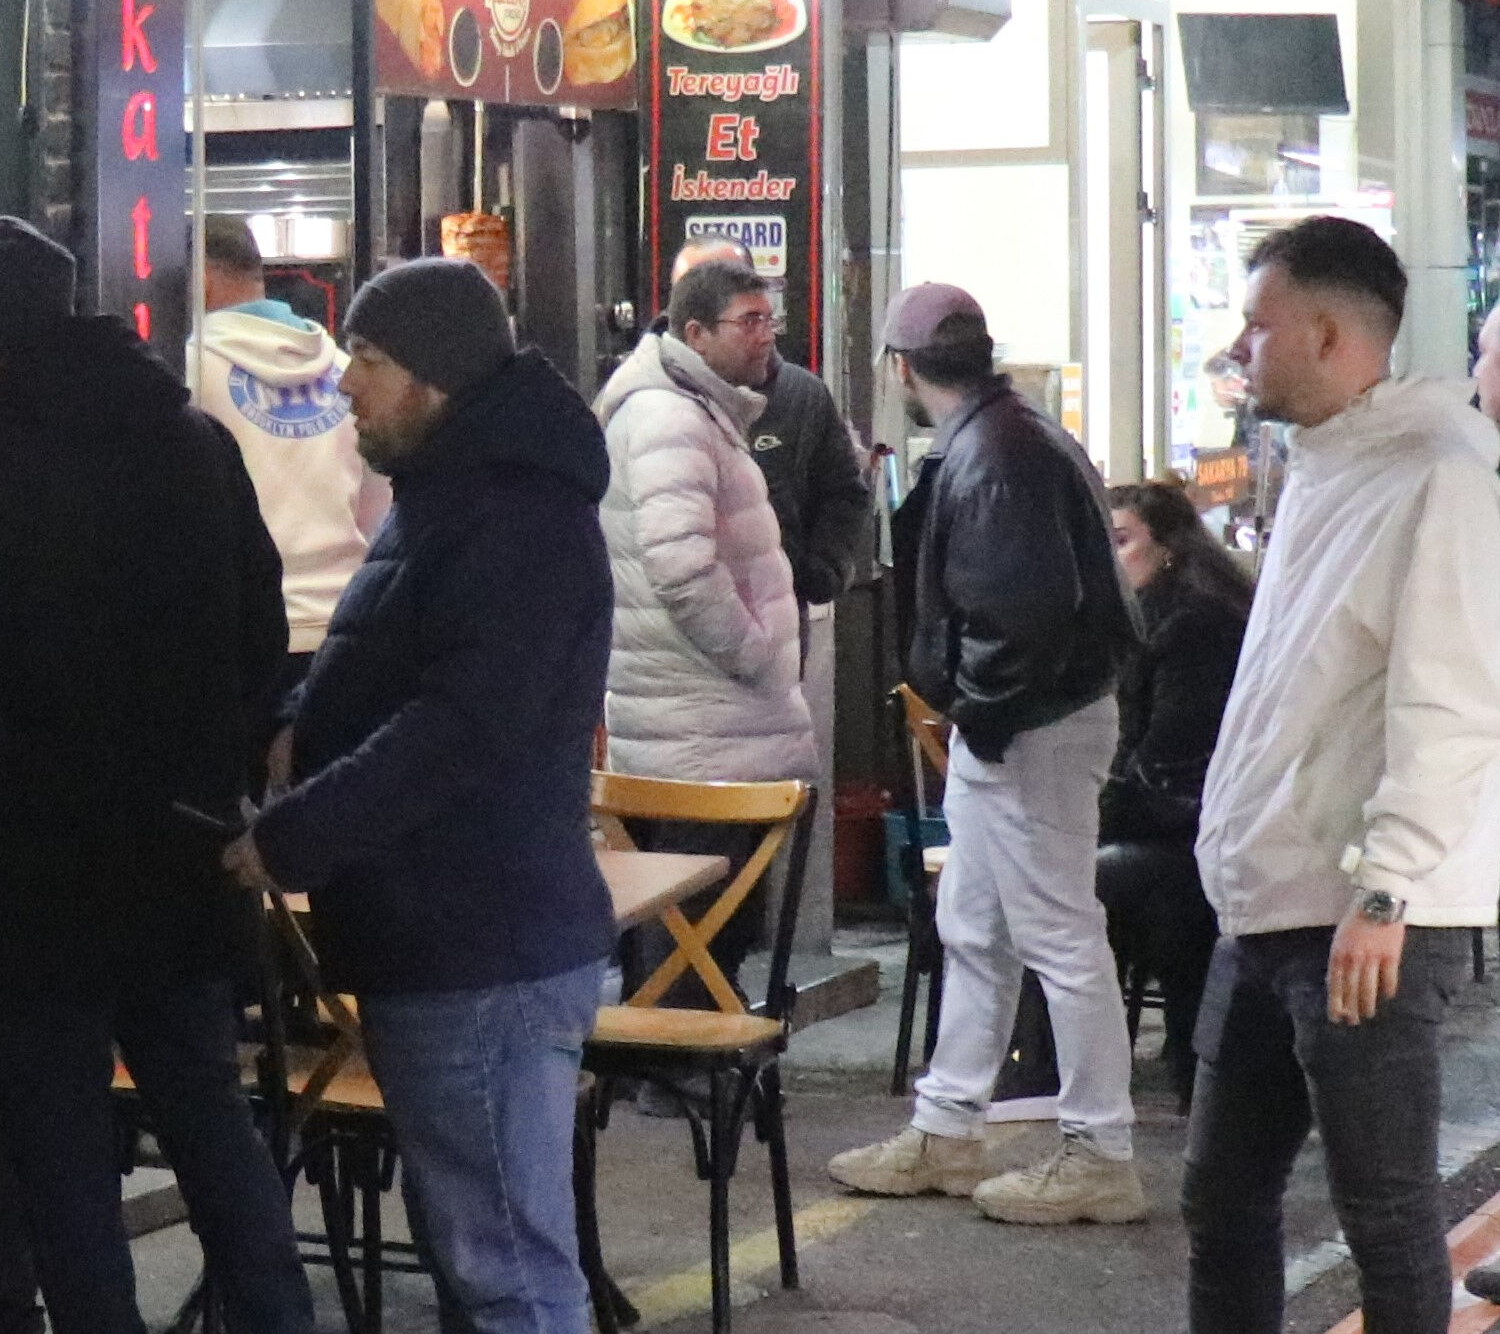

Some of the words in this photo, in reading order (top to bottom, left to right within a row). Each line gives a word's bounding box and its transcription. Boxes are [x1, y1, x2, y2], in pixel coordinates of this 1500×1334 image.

[666, 64, 800, 102] Tereyağlı
[706, 113, 760, 161] Et
[671, 163, 796, 201] İskender
